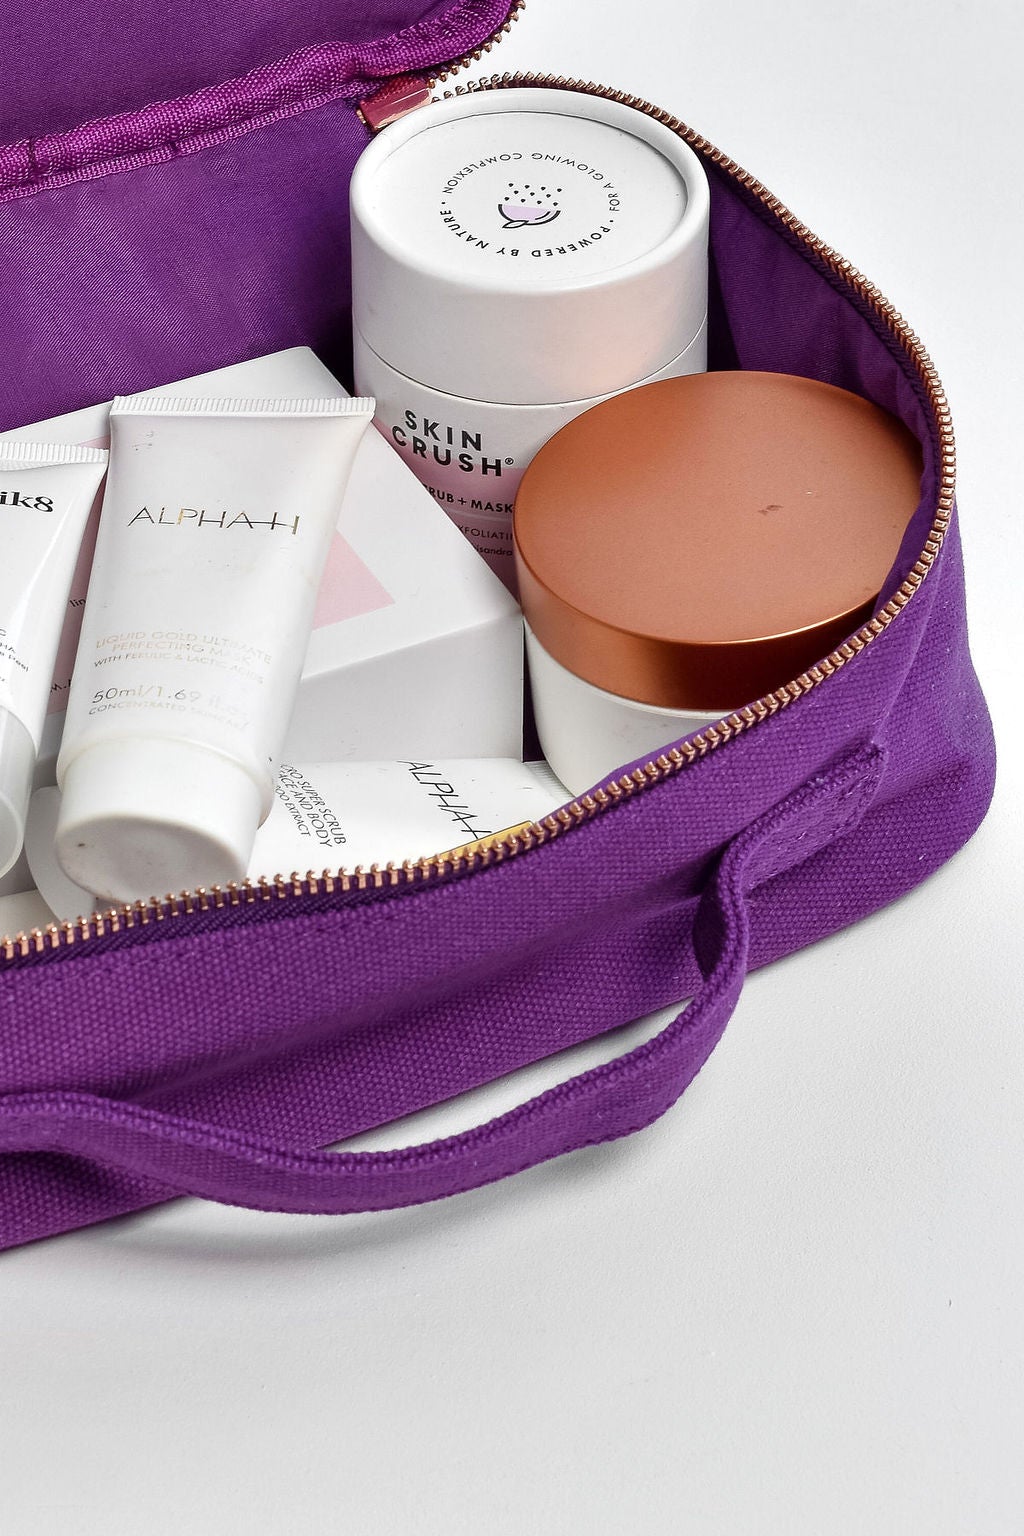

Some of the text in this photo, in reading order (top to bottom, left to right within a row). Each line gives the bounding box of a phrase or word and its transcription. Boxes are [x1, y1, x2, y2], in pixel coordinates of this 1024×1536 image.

[442, 152, 621, 212] FOR A GLOWING COMPLEXION
[439, 209, 611, 258] POWERED BY NATURE
[404, 409, 482, 452] SKIN
[423, 484, 455, 503] RUB
[470, 499, 513, 514] MASK
[458, 524, 513, 540] XFOLIATI
[95, 631, 147, 650] LIQUID
[151, 631, 198, 642] GOLD
[112, 640, 205, 653] PERFECTING
[93, 654, 122, 667] WITH
[284, 802, 311, 836] EXTRACT
[290, 789, 314, 811] AND
[306, 813, 333, 848] BODY
[297, 781, 326, 806] SUPER
[318, 808, 347, 845] SCRUB
